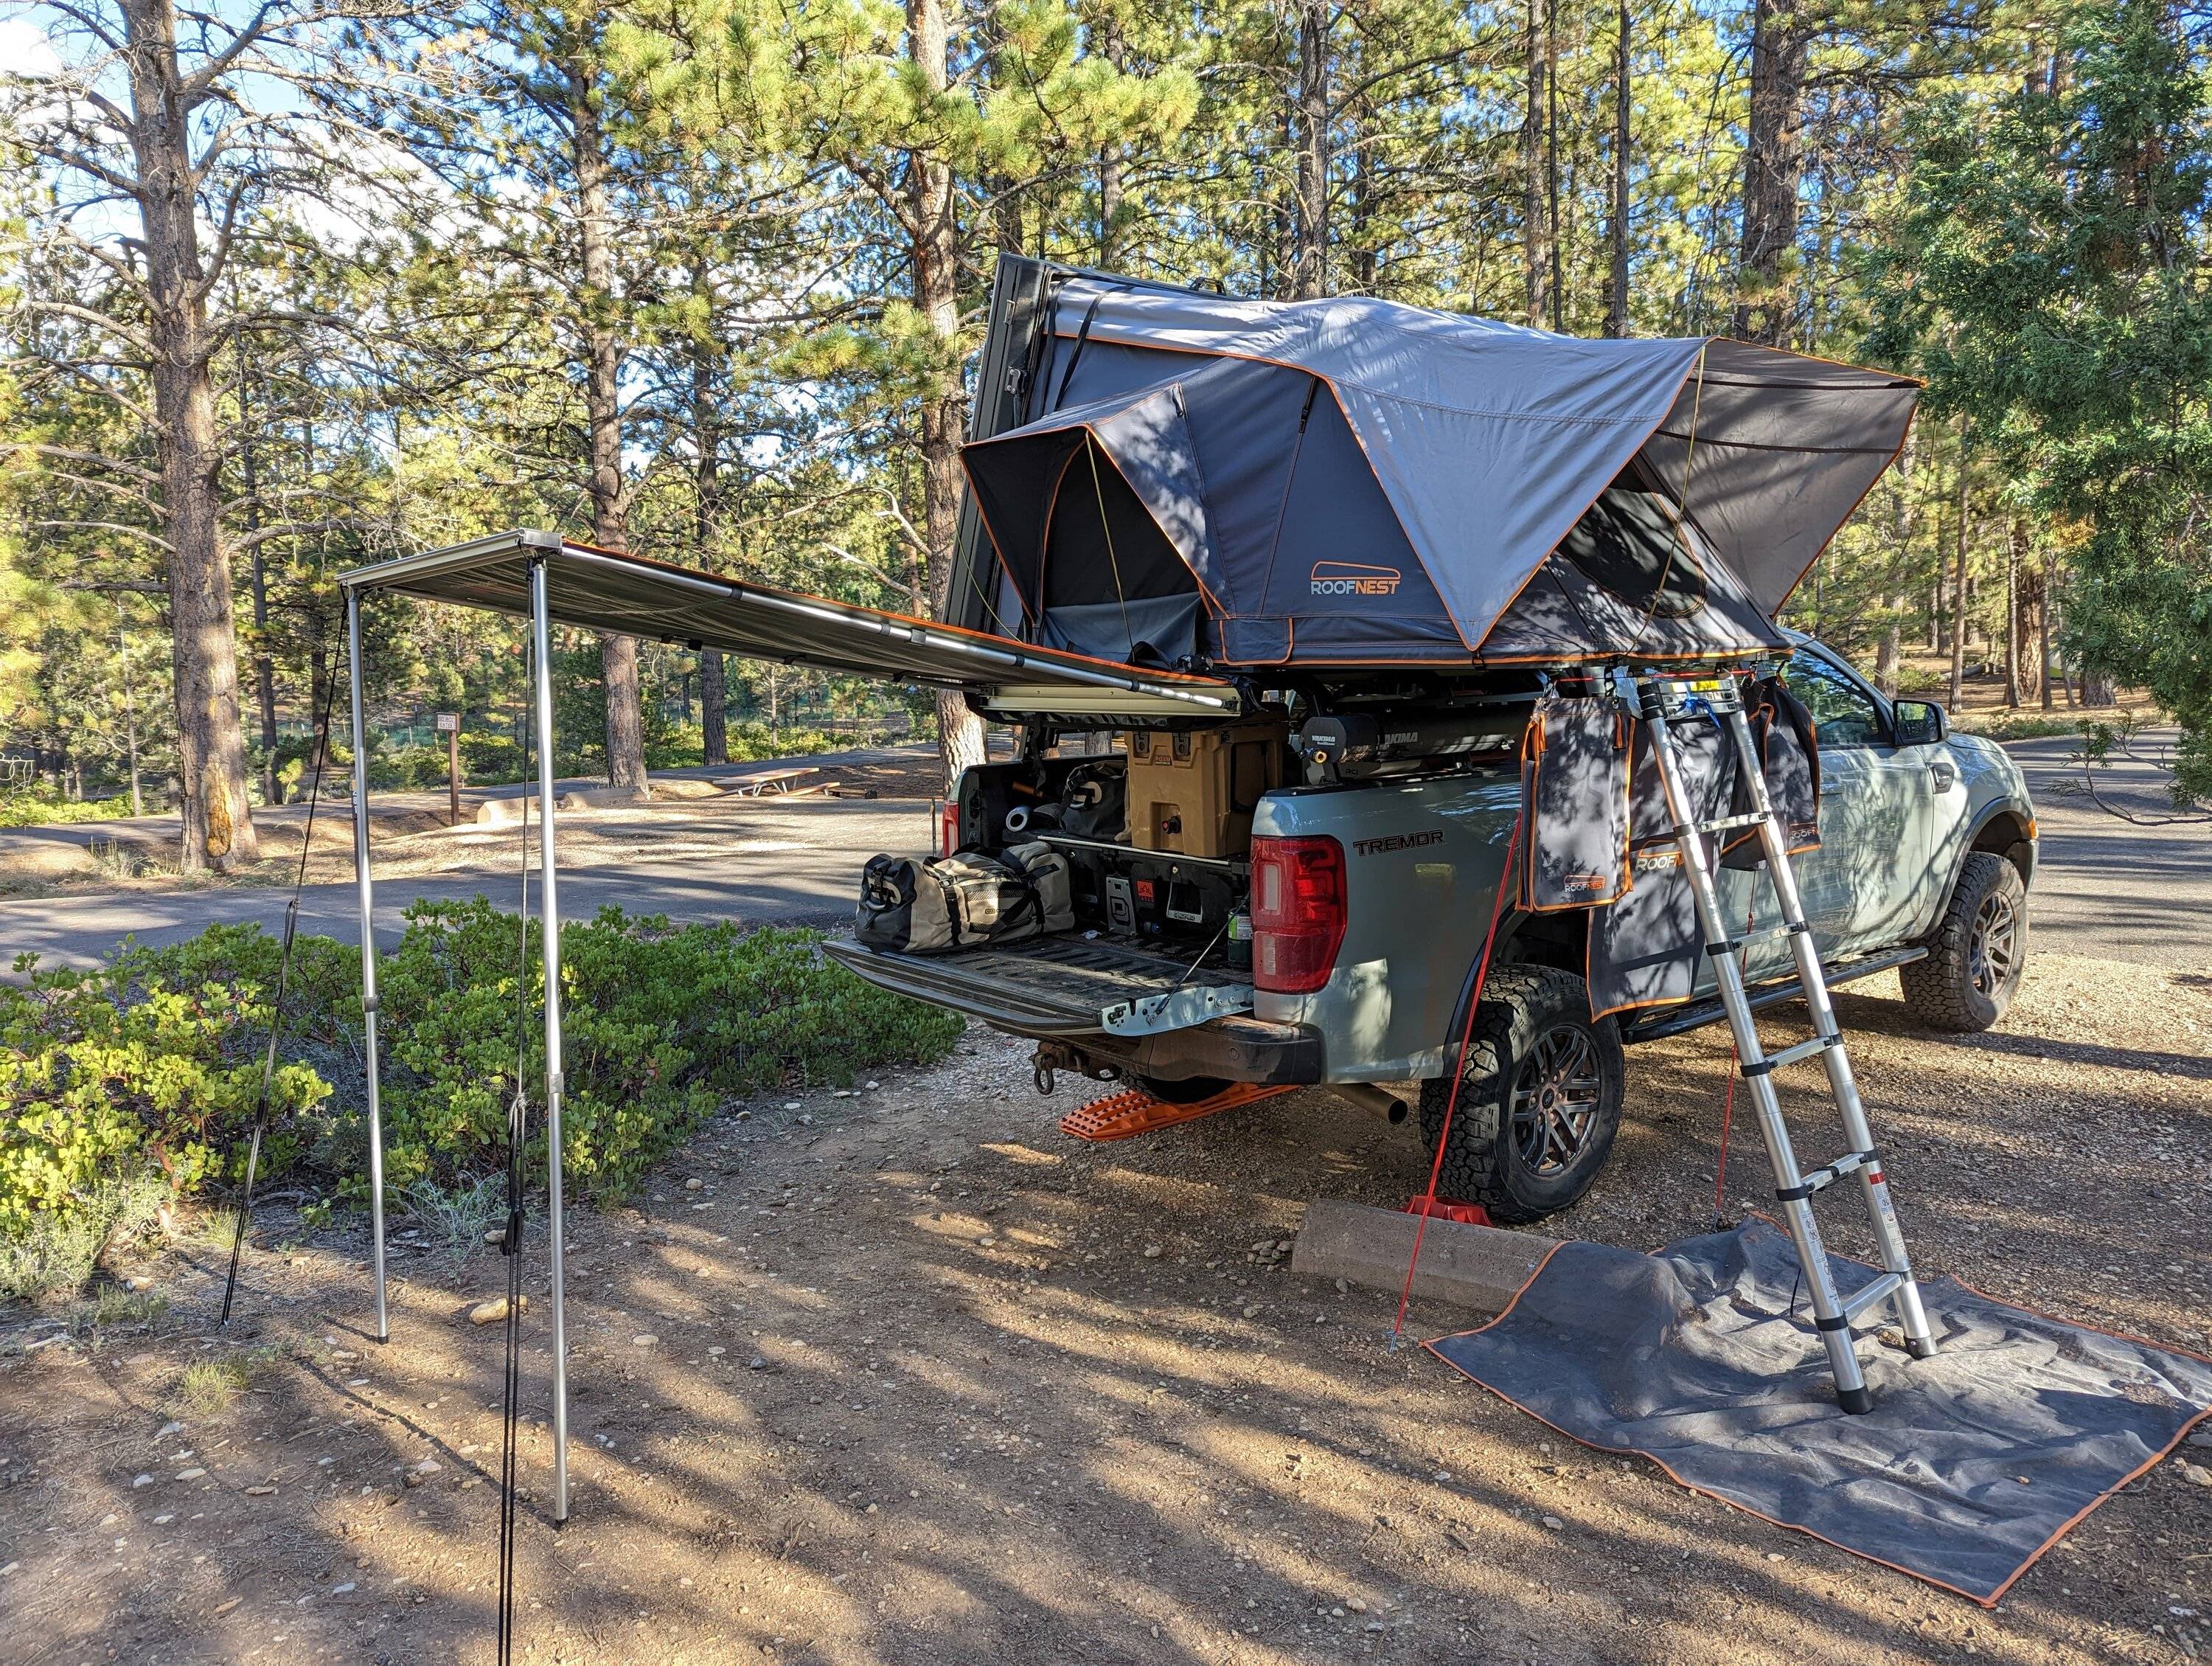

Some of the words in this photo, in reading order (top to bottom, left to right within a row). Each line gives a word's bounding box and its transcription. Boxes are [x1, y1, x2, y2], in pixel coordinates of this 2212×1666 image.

[1310, 580, 1401, 595] ROOFNEST
[1312, 735, 1336, 743] YAKIMA
[1384, 732, 1419, 745] AKIMA
[1789, 827, 1820, 839] ROOFN
[1353, 828, 1446, 857] TREMOR
[1635, 855, 1685, 871] ROOFN
[1564, 881, 1605, 892] ROOFNEST
